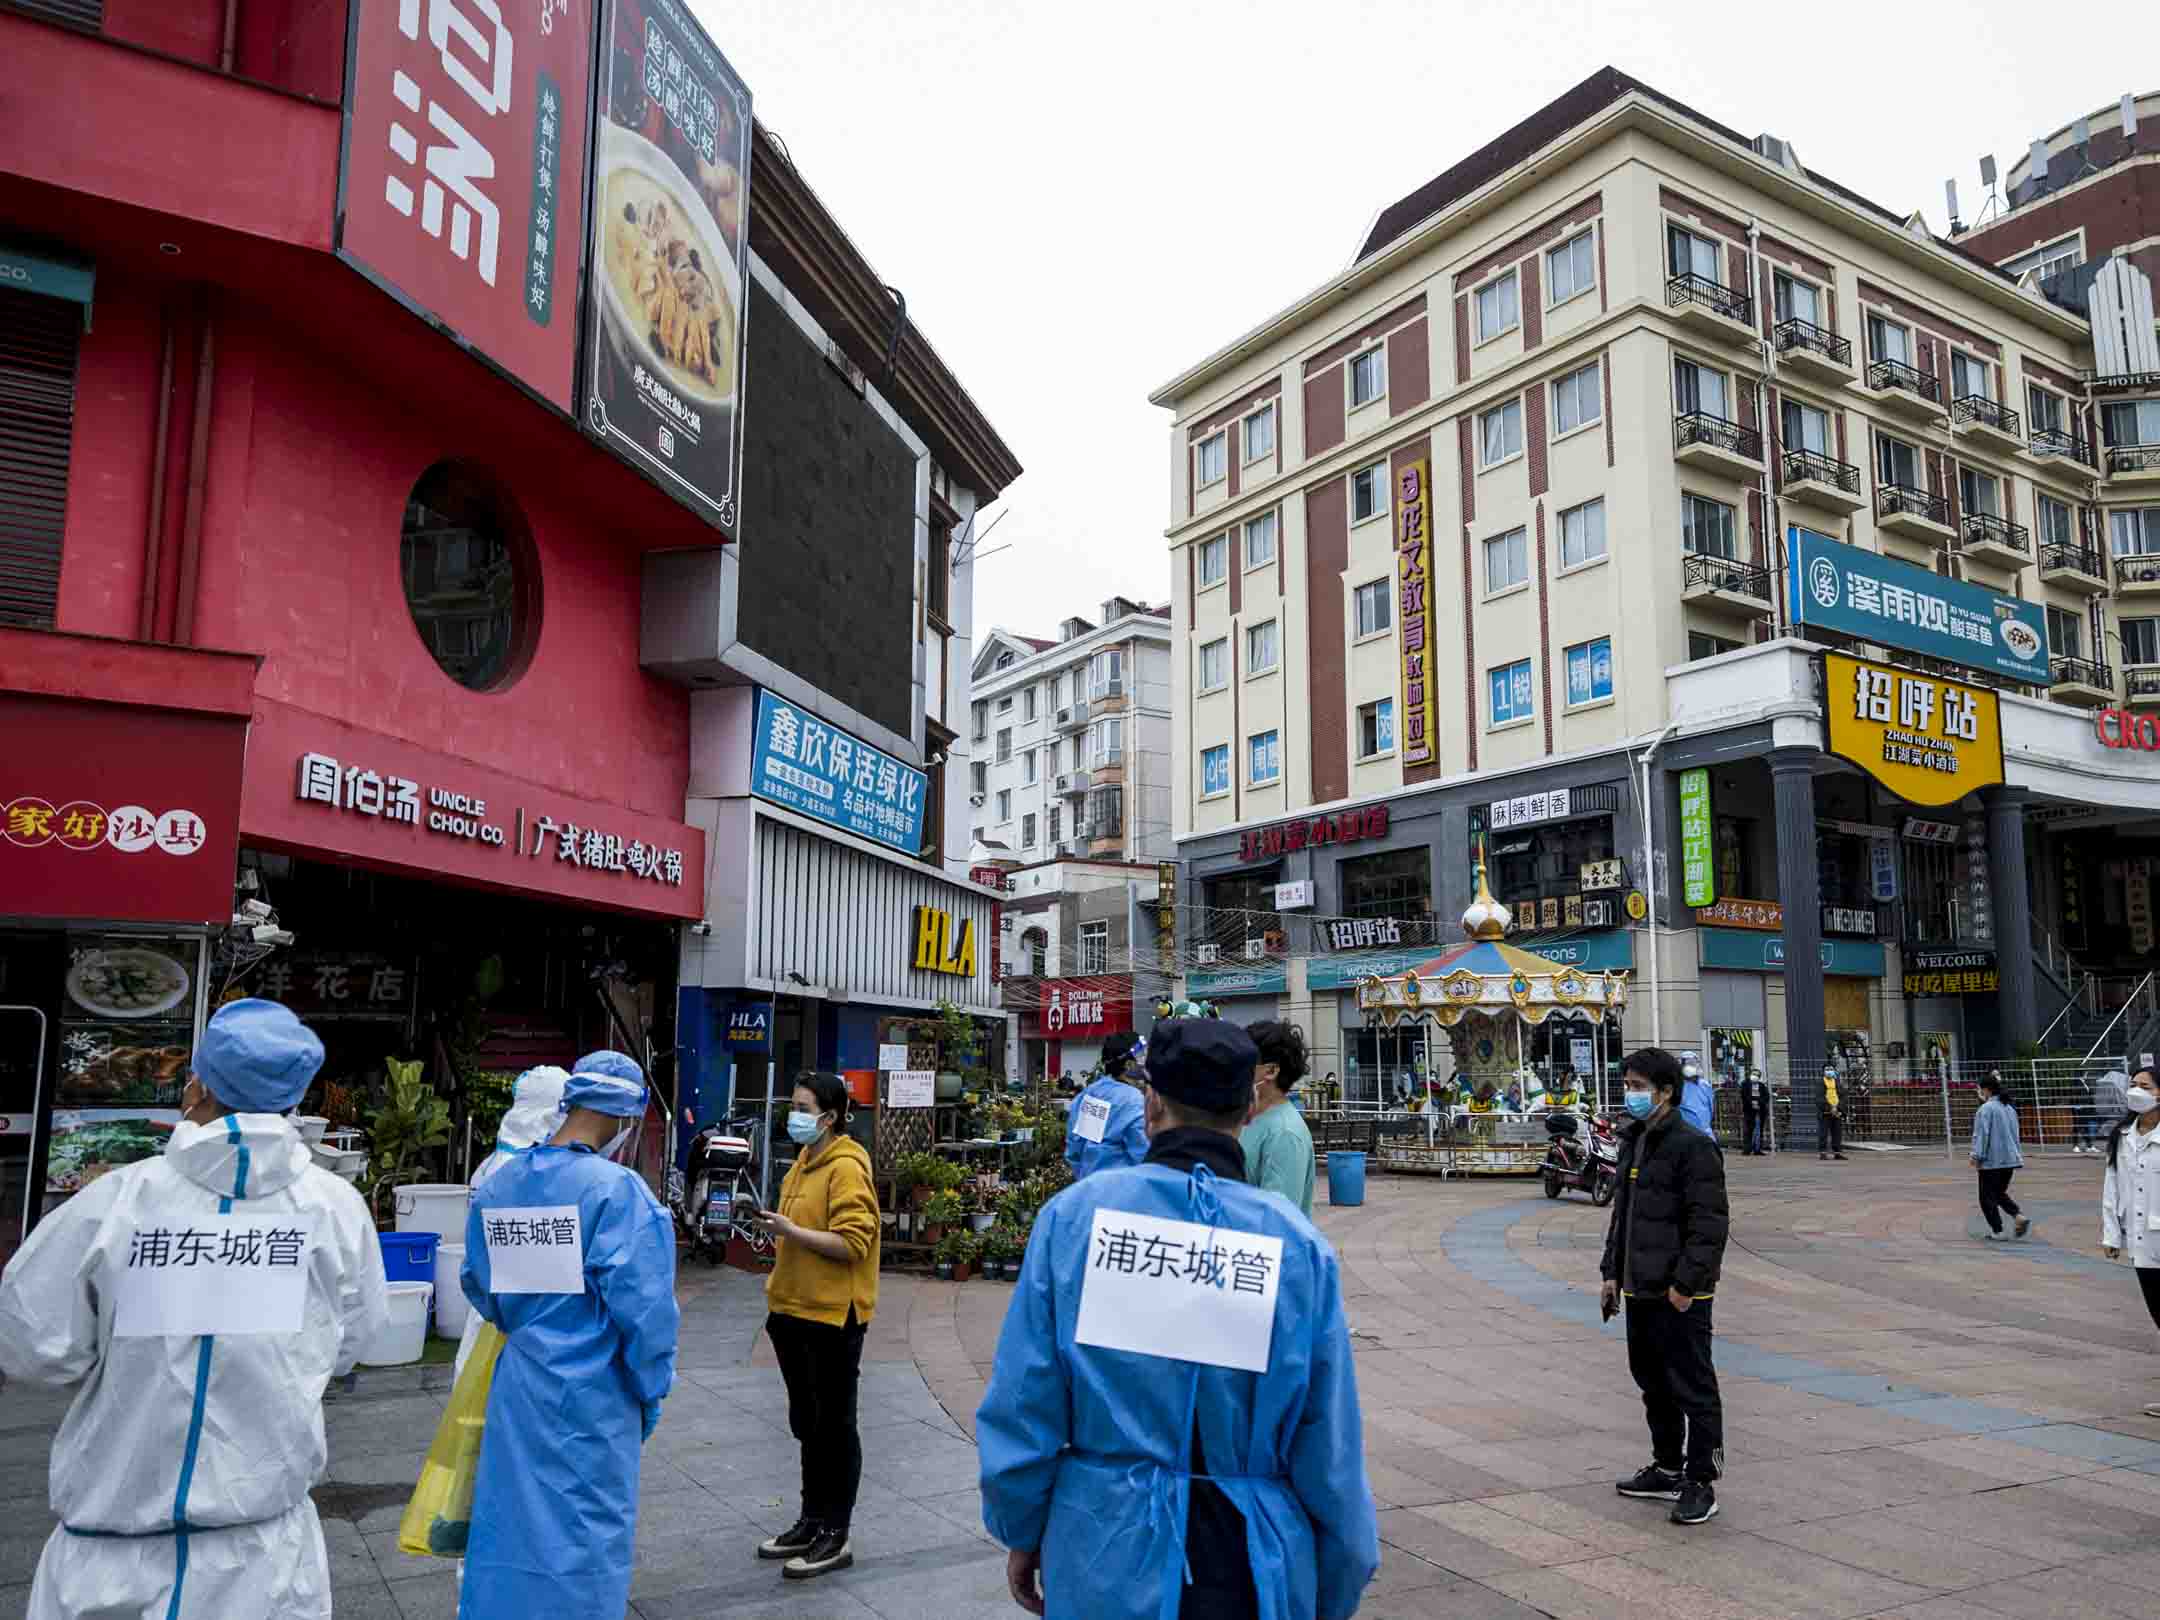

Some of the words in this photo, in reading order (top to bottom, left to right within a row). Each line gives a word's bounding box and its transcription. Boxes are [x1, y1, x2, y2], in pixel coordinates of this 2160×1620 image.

[1846, 571, 1949, 635] 溪雨观
[1950, 616, 1993, 647] 酸菜鱼
[1856, 666, 1977, 741] 招呼站
[1883, 743, 1960, 773] 江湖菜小酒馆
[1886, 729, 1914, 746] ZHAO
[1914, 735, 1929, 749] HU
[1929, 737, 1957, 753] ZHAN
[768, 706, 921, 813] 鑫欣保活绿化
[300, 752, 420, 825] 周伯汤
[431, 787, 486, 817] UNCLE
[1493, 792, 1567, 824] 麻辣鲜香
[429, 811, 478, 839] CHOU
[479, 823, 507, 846] CO.
[534, 816, 683, 886] 广式猪肚鸡火锅
[912, 904, 976, 977] HLA
[1330, 915, 1401, 950] 招呼站
[1916, 954, 1987, 968] WELCOME
[729, 1012, 766, 1028] HLA
[128, 1229, 307, 1269] 浦东城管
[487, 1217, 576, 1246] 浦东城管
[1095, 1227, 1274, 1296] 浦东城管
